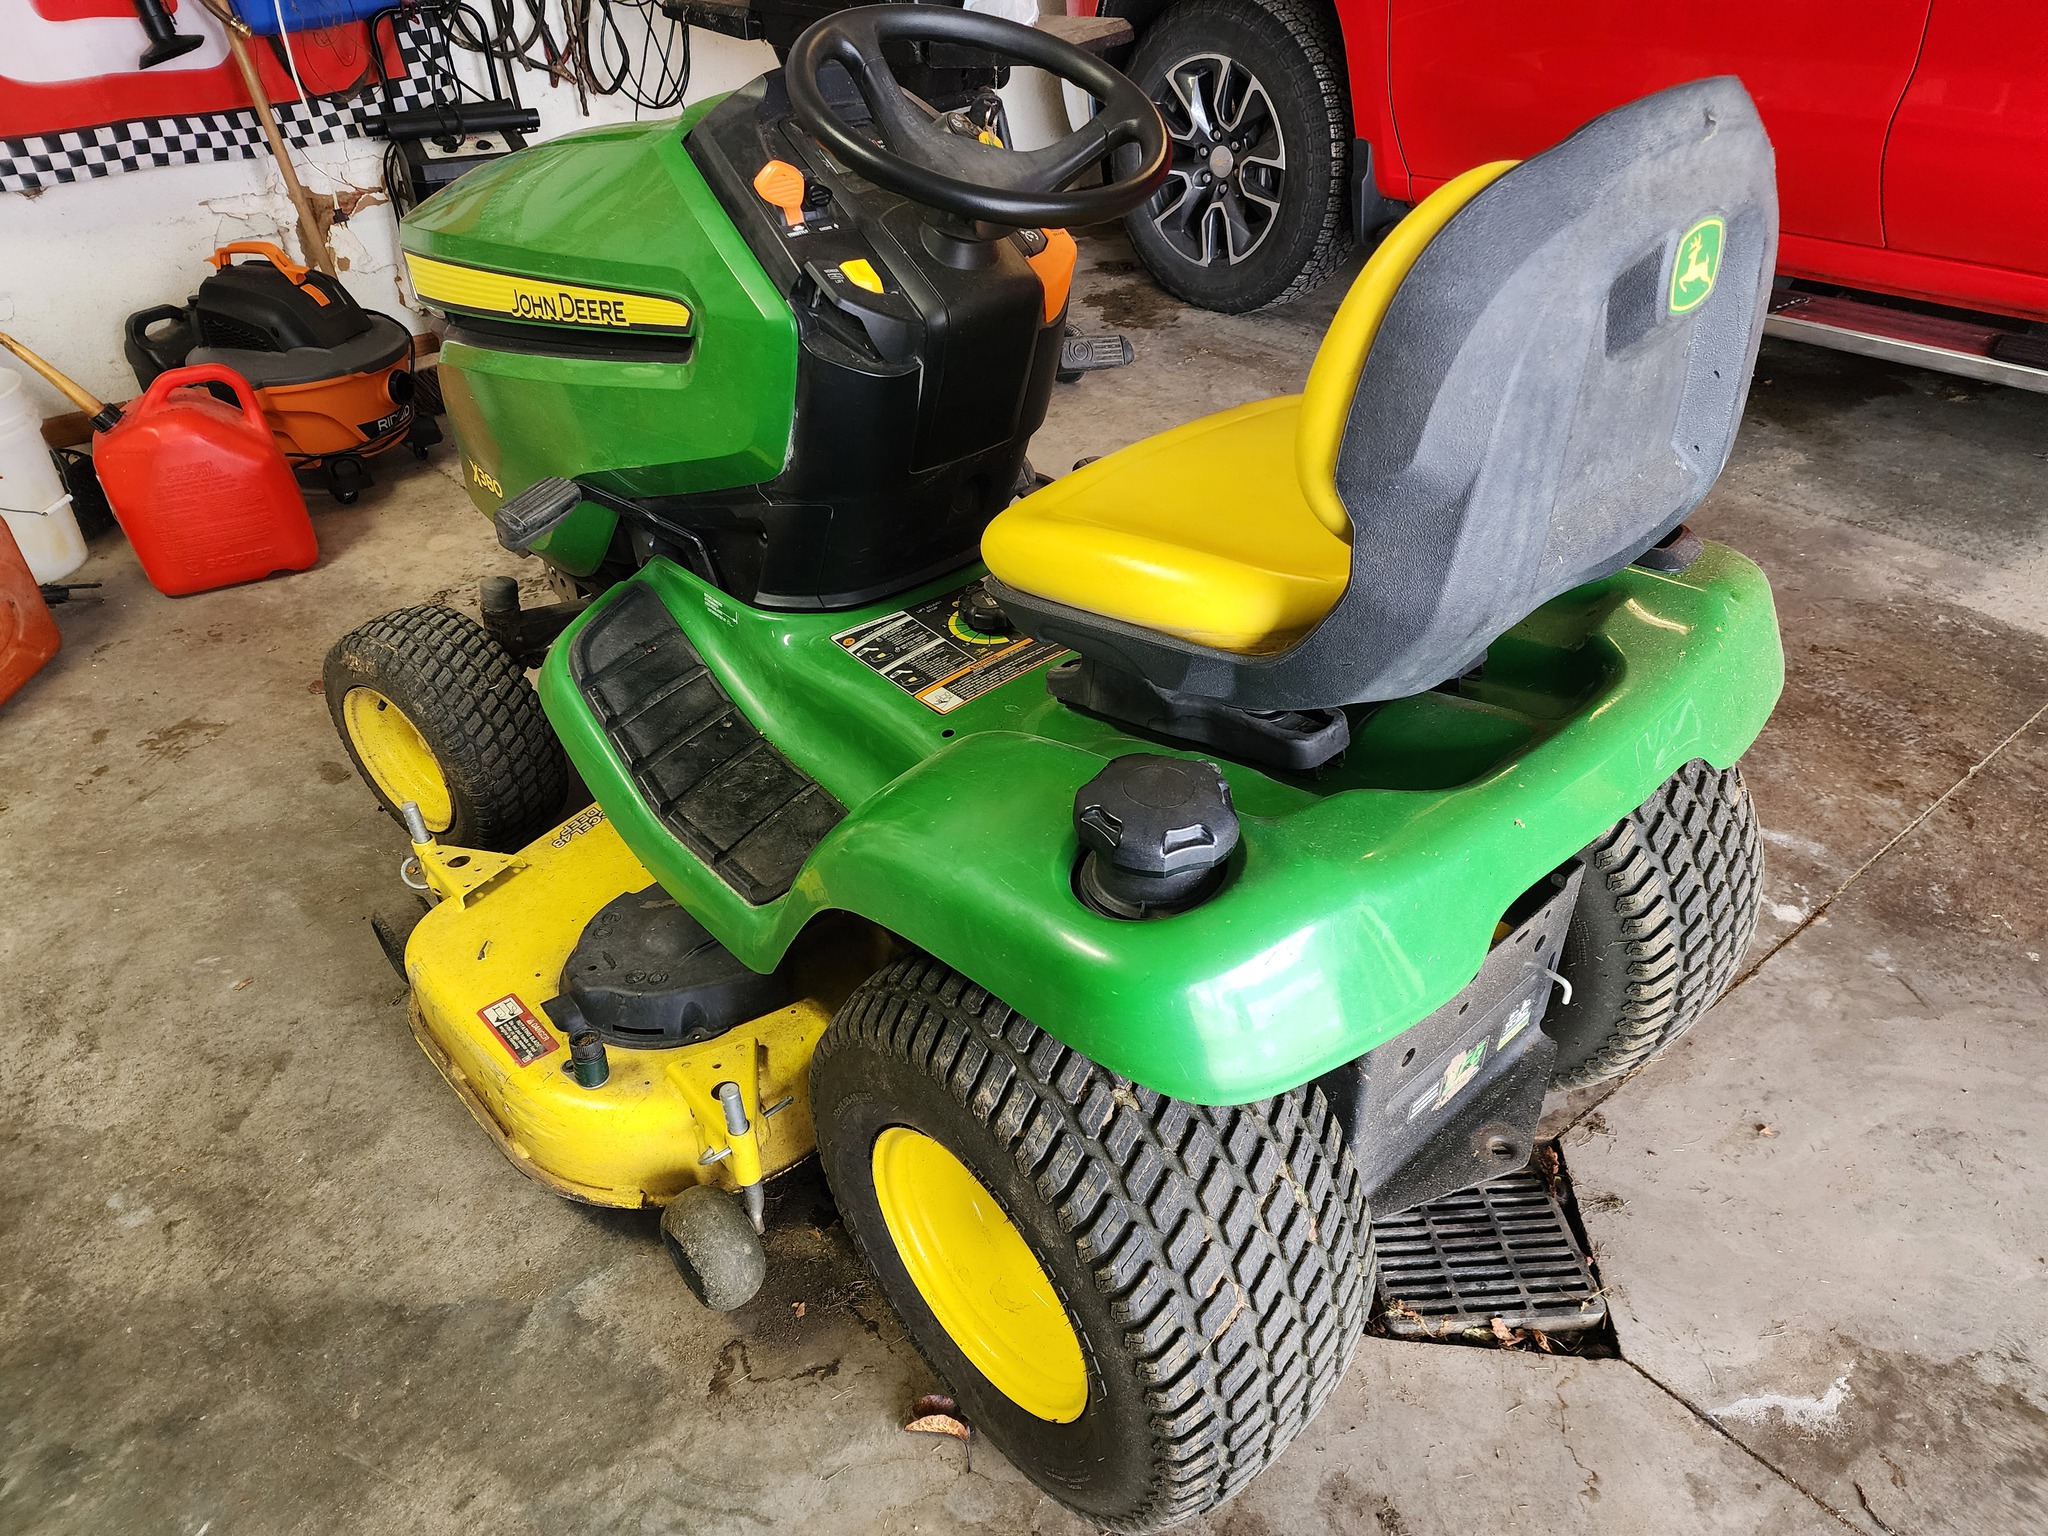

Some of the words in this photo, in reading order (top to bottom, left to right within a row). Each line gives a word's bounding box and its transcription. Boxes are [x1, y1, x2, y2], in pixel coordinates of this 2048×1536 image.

[511, 288, 558, 319] JOHN
[558, 292, 628, 324] DEERE
[468, 459, 504, 499] X380
[560, 807, 600, 836] DEEP
[532, 1022, 550, 1041] DANGER
